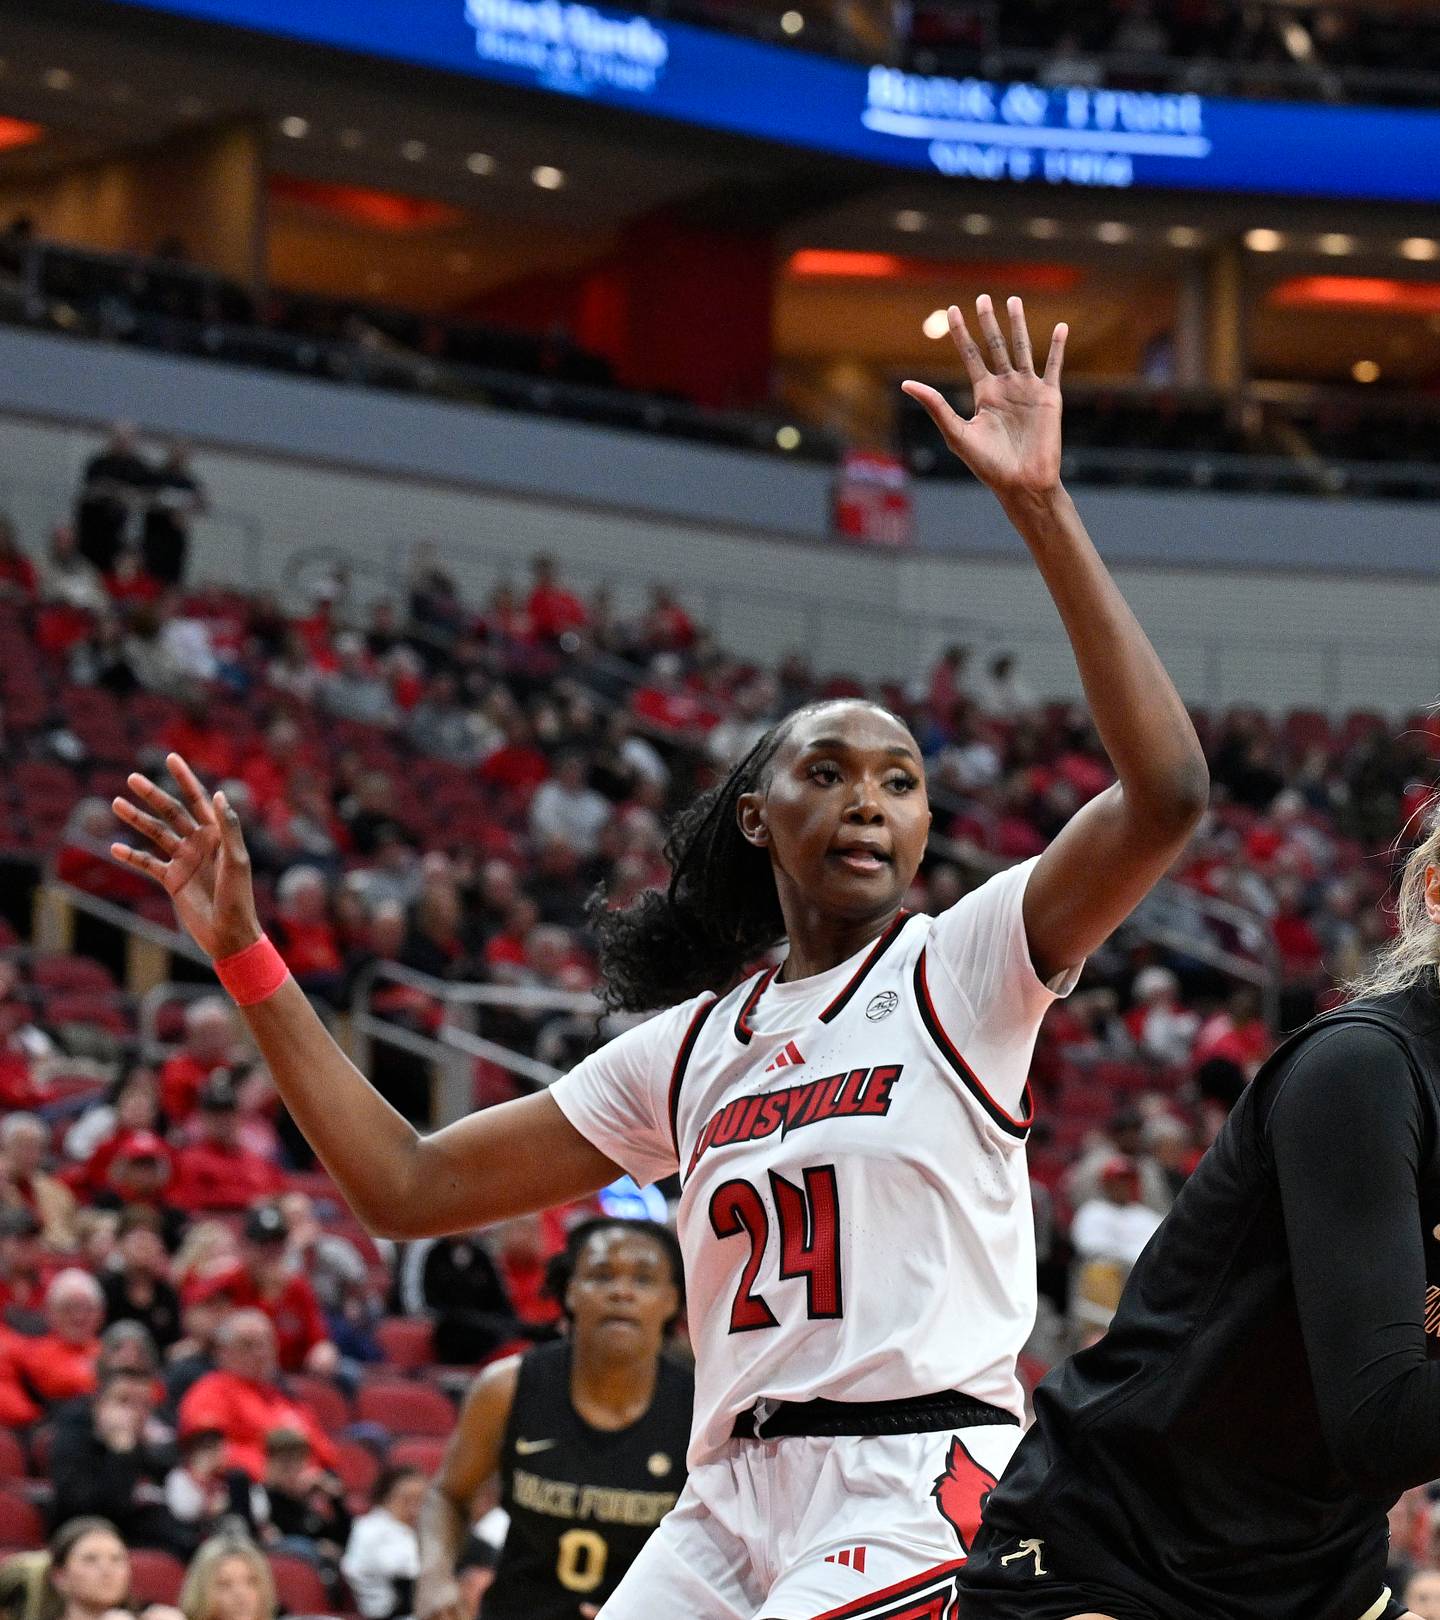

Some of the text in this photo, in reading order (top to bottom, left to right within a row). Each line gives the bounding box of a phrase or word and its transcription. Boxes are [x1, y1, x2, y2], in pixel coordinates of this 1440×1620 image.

[682, 1064, 904, 1187] LOUISVILLE
[708, 1163, 844, 1335] 24
[556, 1528, 609, 1593] 0
